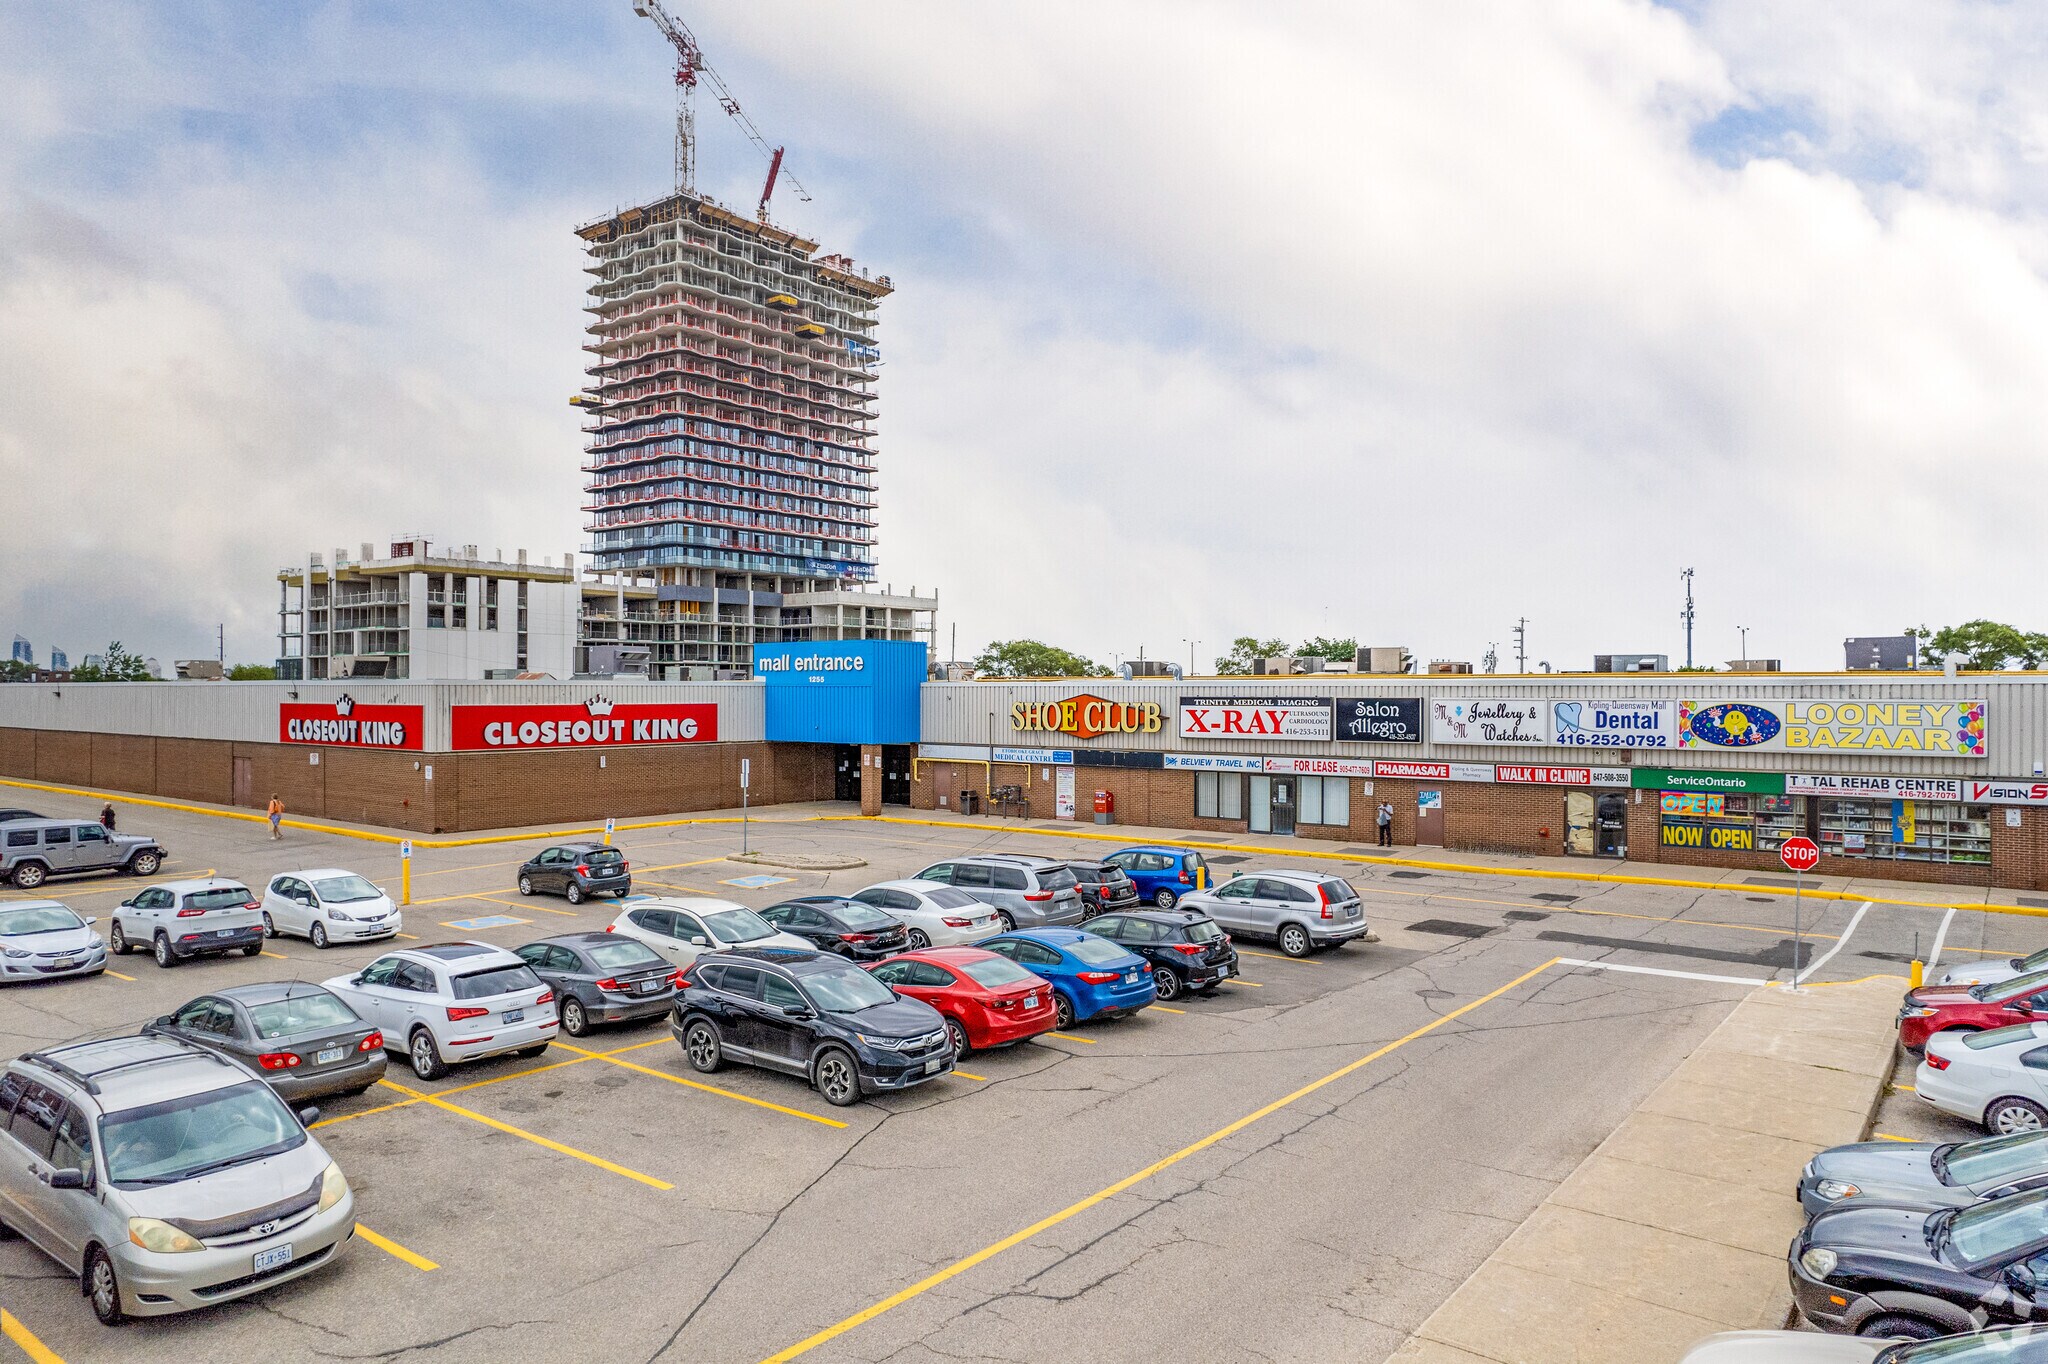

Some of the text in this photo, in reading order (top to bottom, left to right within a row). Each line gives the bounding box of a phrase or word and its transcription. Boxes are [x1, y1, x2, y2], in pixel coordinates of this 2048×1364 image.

[759, 653, 864, 671] mall entrance
[1355, 701, 1400, 717] Salon
[1467, 701, 1537, 727] Jewellery &
[1588, 700, 1667, 711] Kipling-Queensway Mall
[1011, 701, 1162, 733] SHOE CLUB
[1185, 709, 1289, 734] X-RAY
[1434, 703, 1448, 720] M
[1453, 722, 1469, 739] M
[1595, 710, 1658, 730] Dental
[1785, 703, 1954, 727] LOONEY
[288, 718, 405, 746] CLOSEOUT KING
[484, 718, 698, 745] CLOSEOUT KING
[1285, 728, 1329, 736] 416-253-5111
[1348, 718, 1407, 738] Allegro
[1480, 723, 1533, 741] Watches
[1556, 733, 1667, 747] 416-252-0792
[1785, 726, 1954, 752] BAZAAR
[994, 753, 1025, 761] MEDICAL
[1026, 754, 1052, 762] CENTRE
[1180, 758, 1212, 767] BELVIEW
[1215, 759, 1243, 768] TRAVEL
[1246, 760, 1262, 769] INC.
[1294, 760, 1310, 771] FOR
[1312, 761, 1338, 773] LEASE
[1377, 764, 1447, 777] PHARMASAVE
[1499, 768, 1588, 784] WALK IN CLINIC
[1593, 772, 1629, 782] 647-508-3550
[1667, 775, 1746, 787] ServiceOntario
[1841, 777, 1890, 789] REHAB
[1895, 779, 1956, 792] CENTRE
[1898, 790, 1957, 799] 416-792-7079
[1661, 794, 1723, 814] OPEN
[1663, 825, 1753, 850] NOW OPEN
[1783, 846, 1817, 861] STOP
